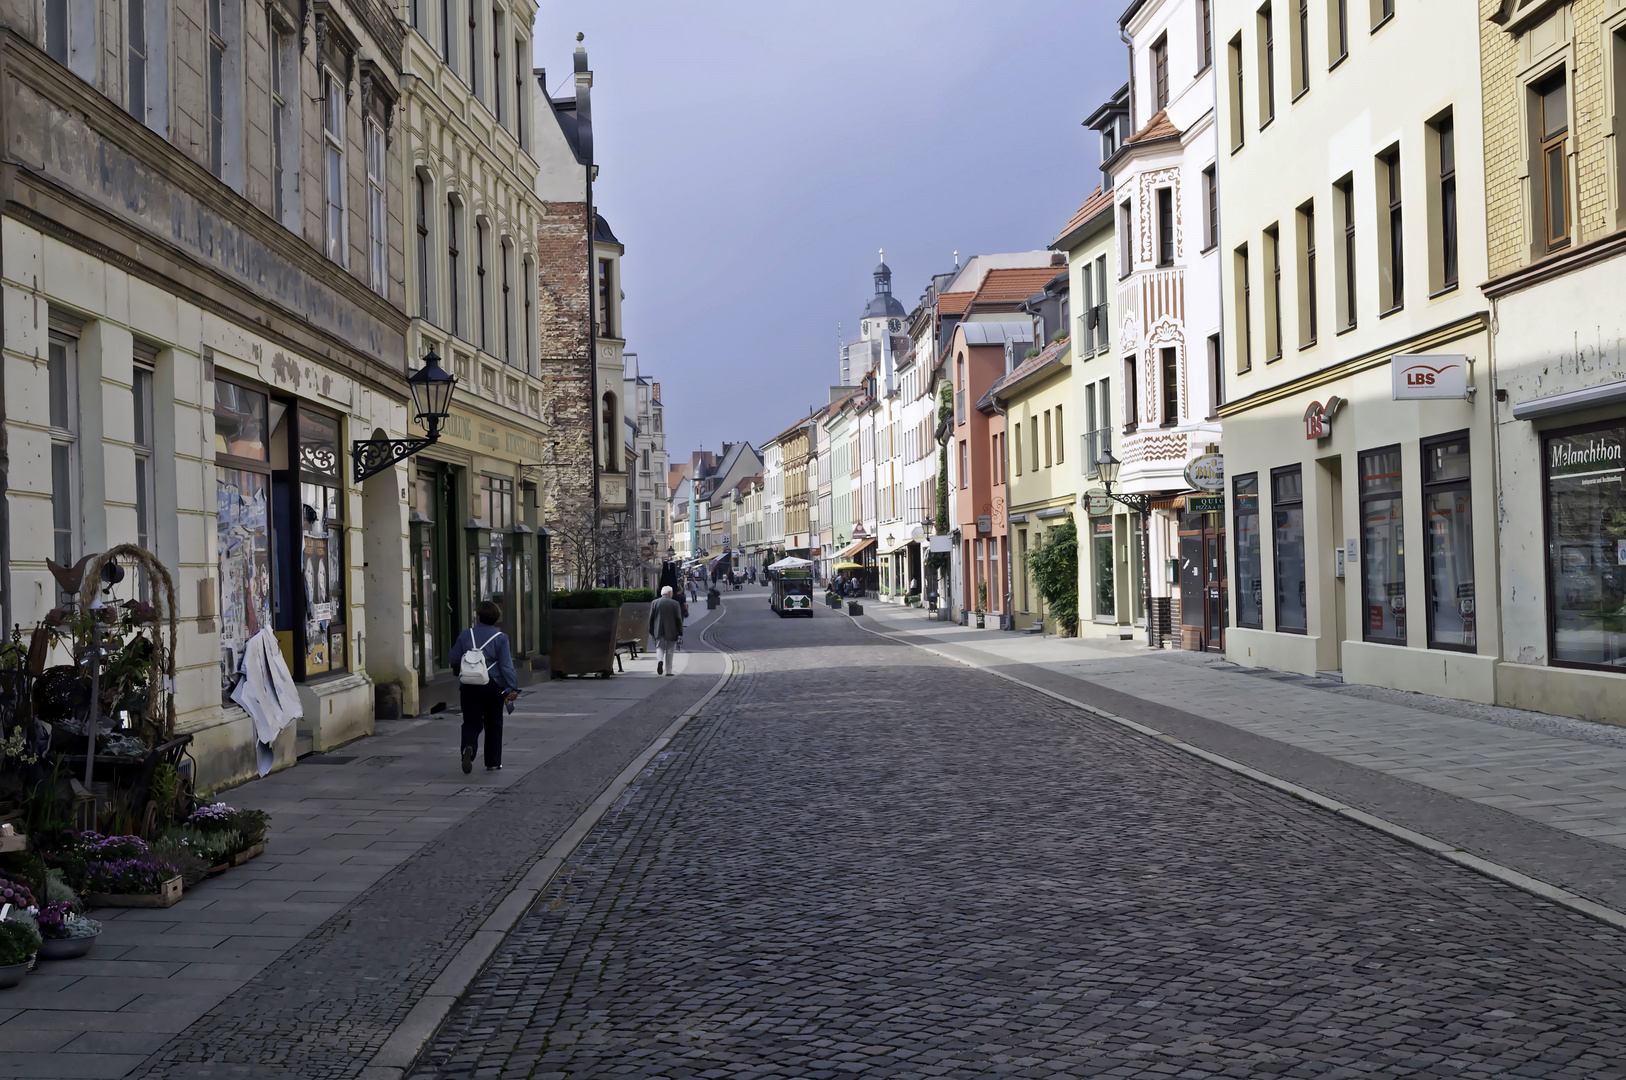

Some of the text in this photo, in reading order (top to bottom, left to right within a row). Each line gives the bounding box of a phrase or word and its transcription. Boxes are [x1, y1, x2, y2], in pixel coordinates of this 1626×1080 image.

[1407, 373, 1435, 385] LBS
[1306, 413, 1323, 440] LBS
[1551, 438, 1621, 468] Melanchthon
